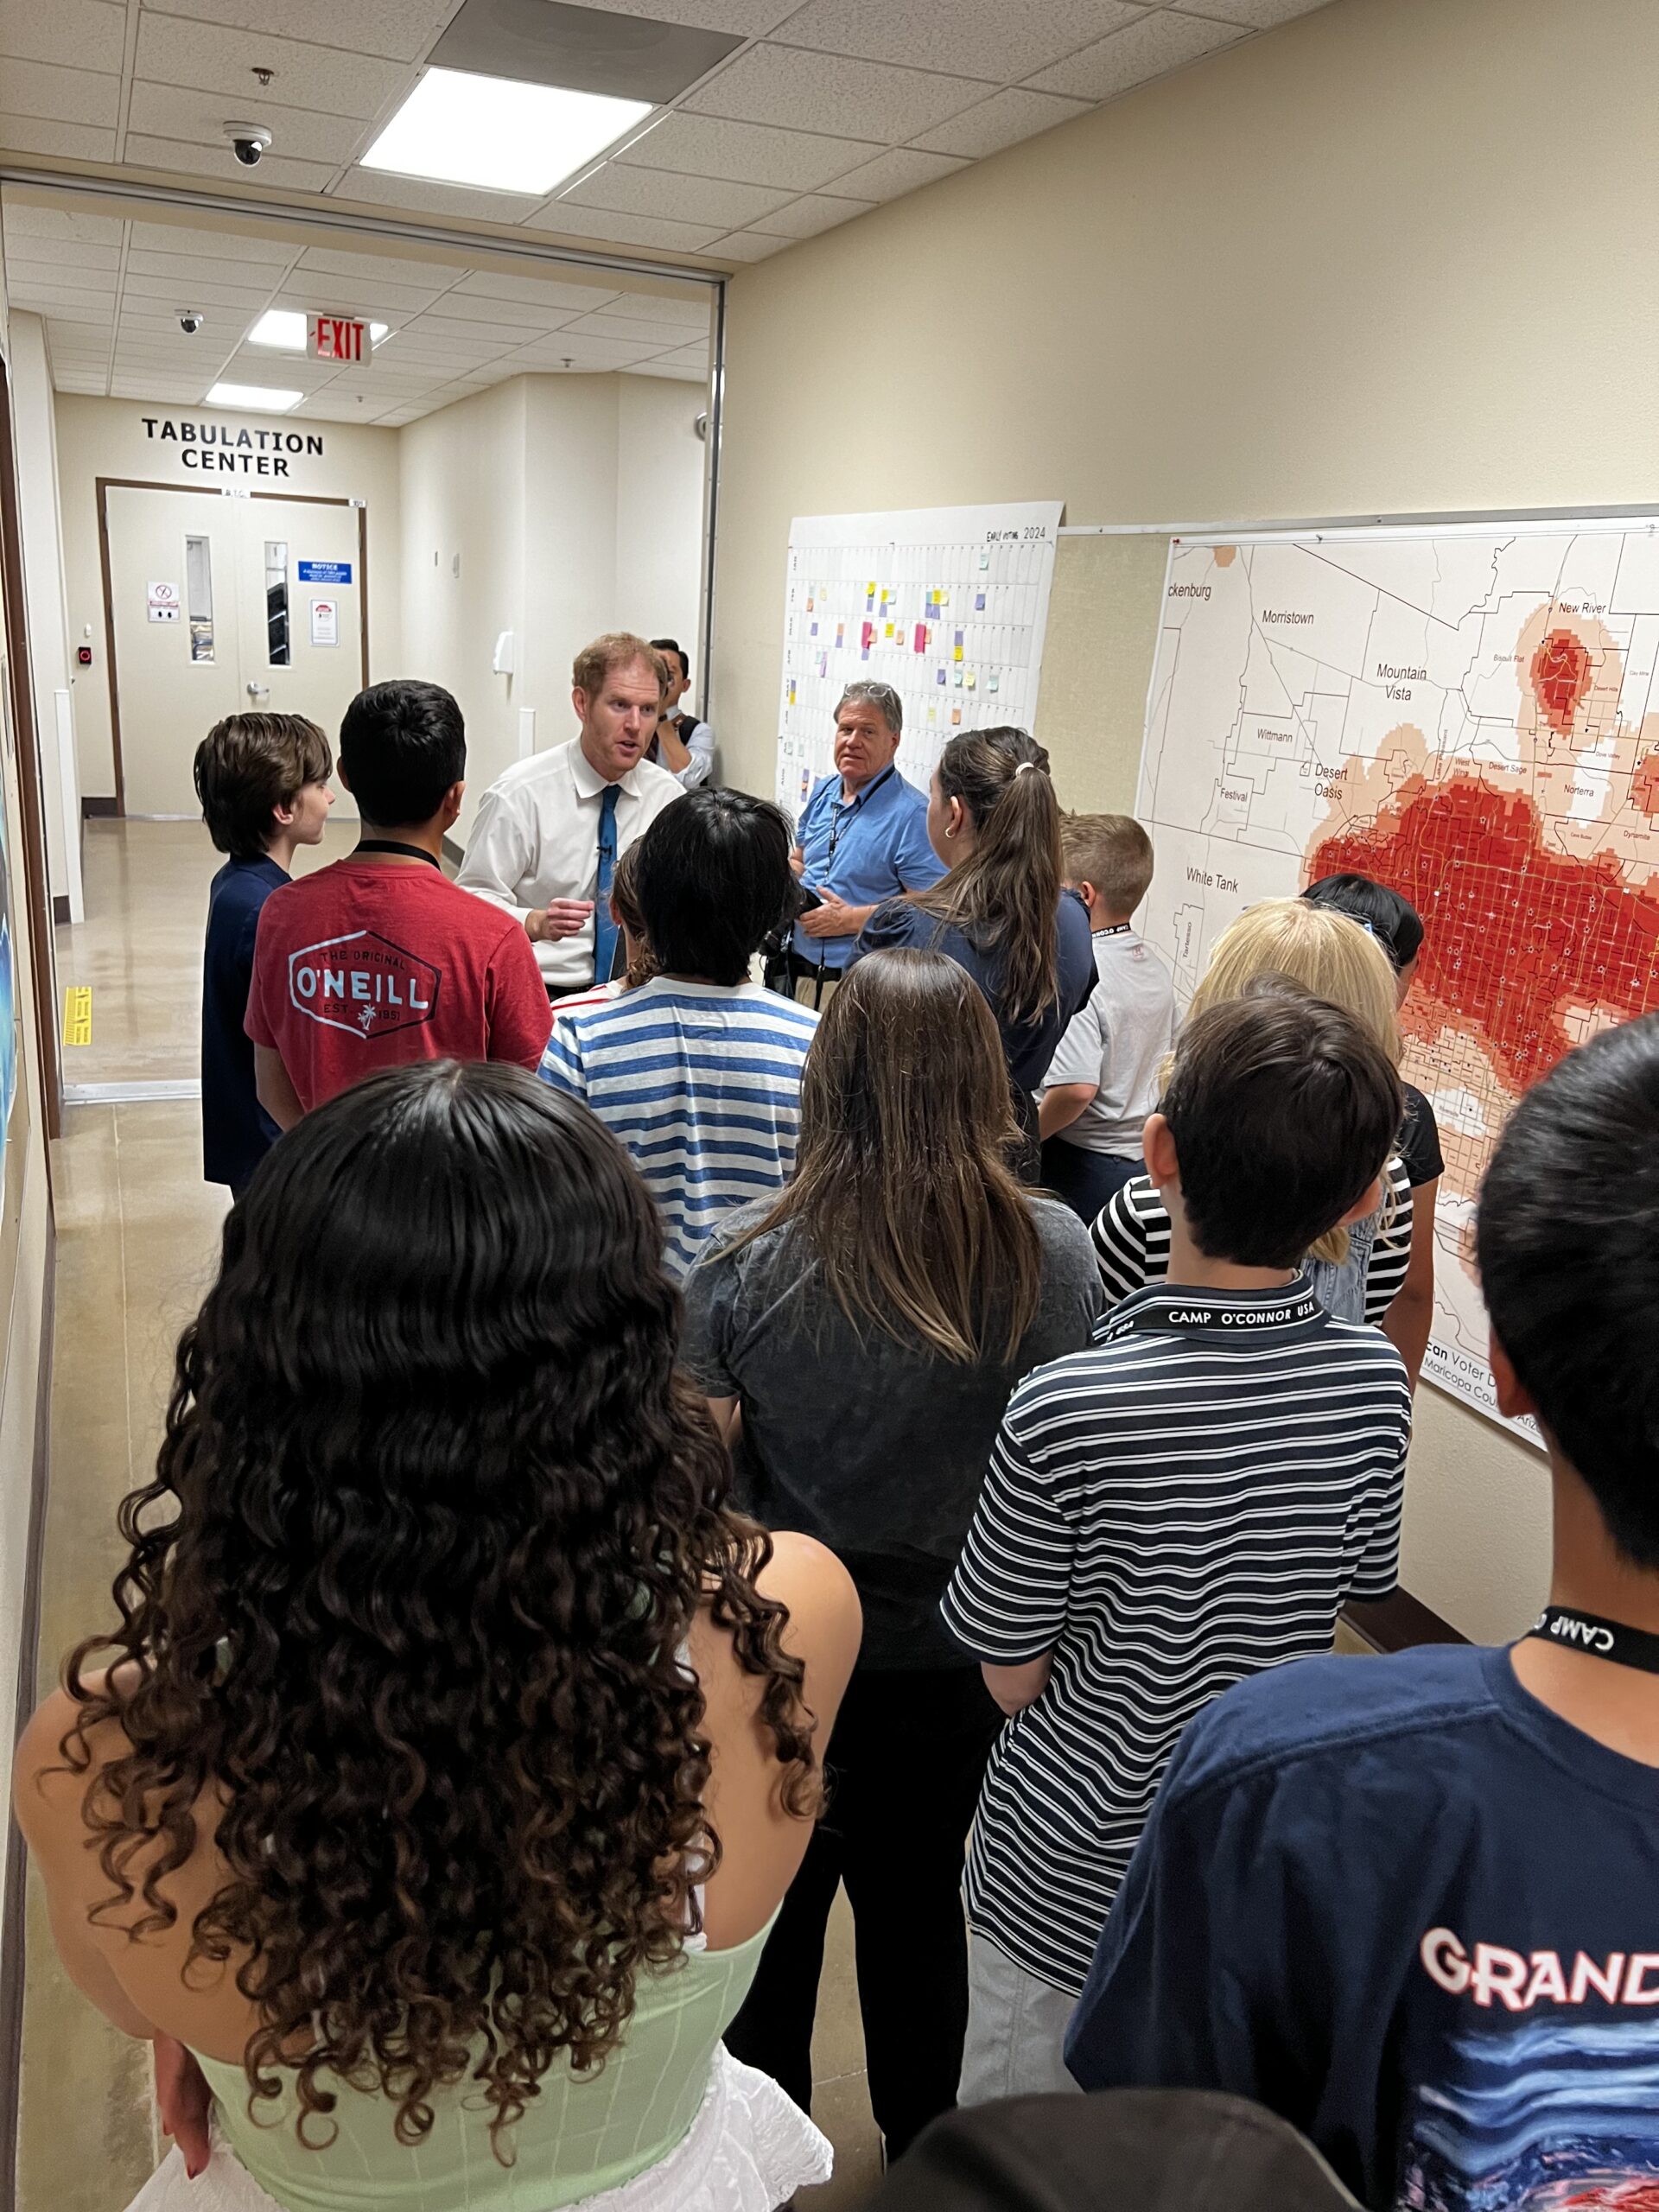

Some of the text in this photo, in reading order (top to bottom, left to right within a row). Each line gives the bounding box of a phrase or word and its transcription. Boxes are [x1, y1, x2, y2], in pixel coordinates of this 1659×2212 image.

[317, 318, 364, 361] EXIT
[142, 418, 324, 455] TABULATION
[181, 448, 289, 477] CENTER
[1023, 526, 1046, 539] 2024
[1559, 602, 1606, 613] New River
[1262, 610, 1314, 625] Morristown
[1376, 664, 1427, 681] Mountain
[1385, 685, 1412, 701] Vista
[1257, 728, 1293, 742] Wittmann
[1455, 758, 1471, 766] West
[1488, 761, 1528, 774] Desert Sage
[1315, 763, 1348, 780] Desert
[1220, 788, 1249, 803] Festival
[1314, 783, 1343, 800] Oasis
[1564, 785, 1594, 797] Norterra
[1624, 830, 1650, 841] Dynamite
[1186, 867, 1239, 893] White Tank
[1182, 921, 1192, 958] Tartesso
[319, 950, 406, 970] THE ORIGINAL
[296, 967, 429, 1009] O'NEILL
[324, 1004, 349, 1014] EST
[1168, 1300, 1315, 1325] CAMP O'CONNOR USA
[1452, 1352, 1484, 1381] Voter
[1424, 1357, 1471, 1391] Maricopa
[1473, 1386, 1498, 1407] Cou
[1550, 1615, 1614, 1651] CAMP
